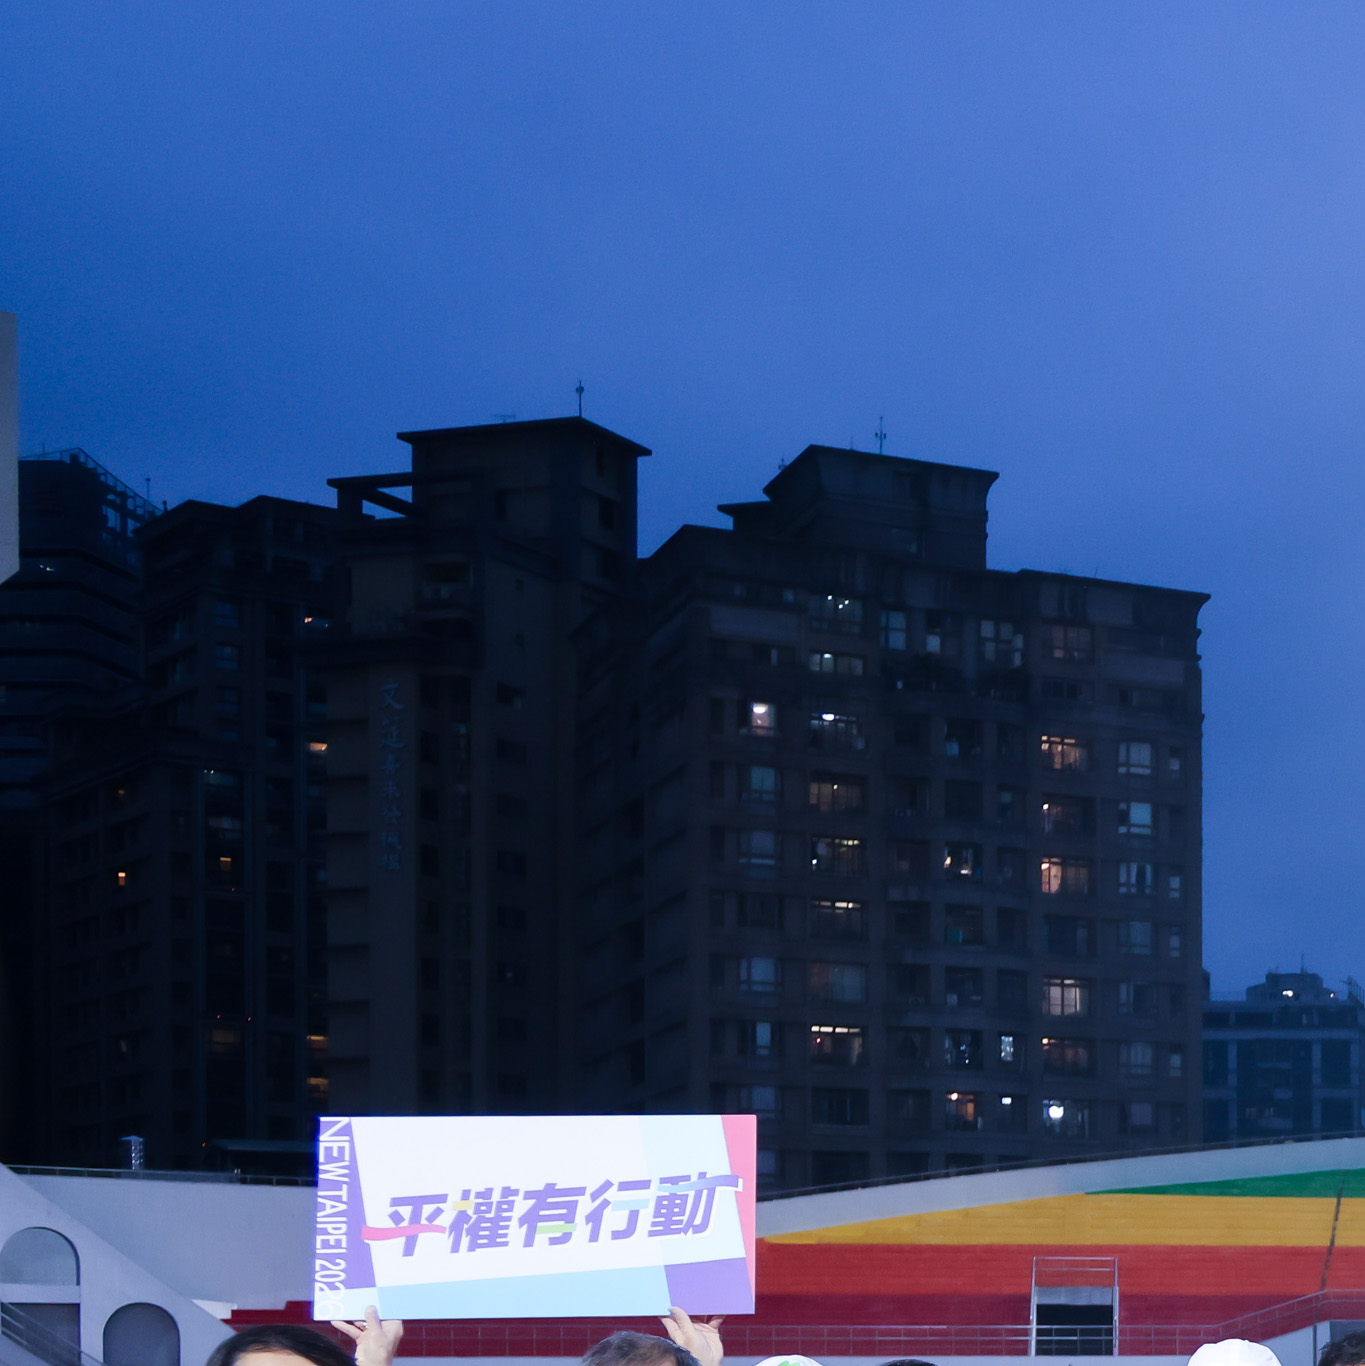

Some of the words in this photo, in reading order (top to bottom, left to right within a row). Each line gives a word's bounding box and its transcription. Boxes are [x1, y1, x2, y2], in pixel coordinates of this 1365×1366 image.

[319, 1116, 350, 1182] NEW
[316, 1184, 348, 1254] TAIPEI
[361, 1171, 742, 1258] 平權有行動
[314, 1258, 346, 1320] 2026
